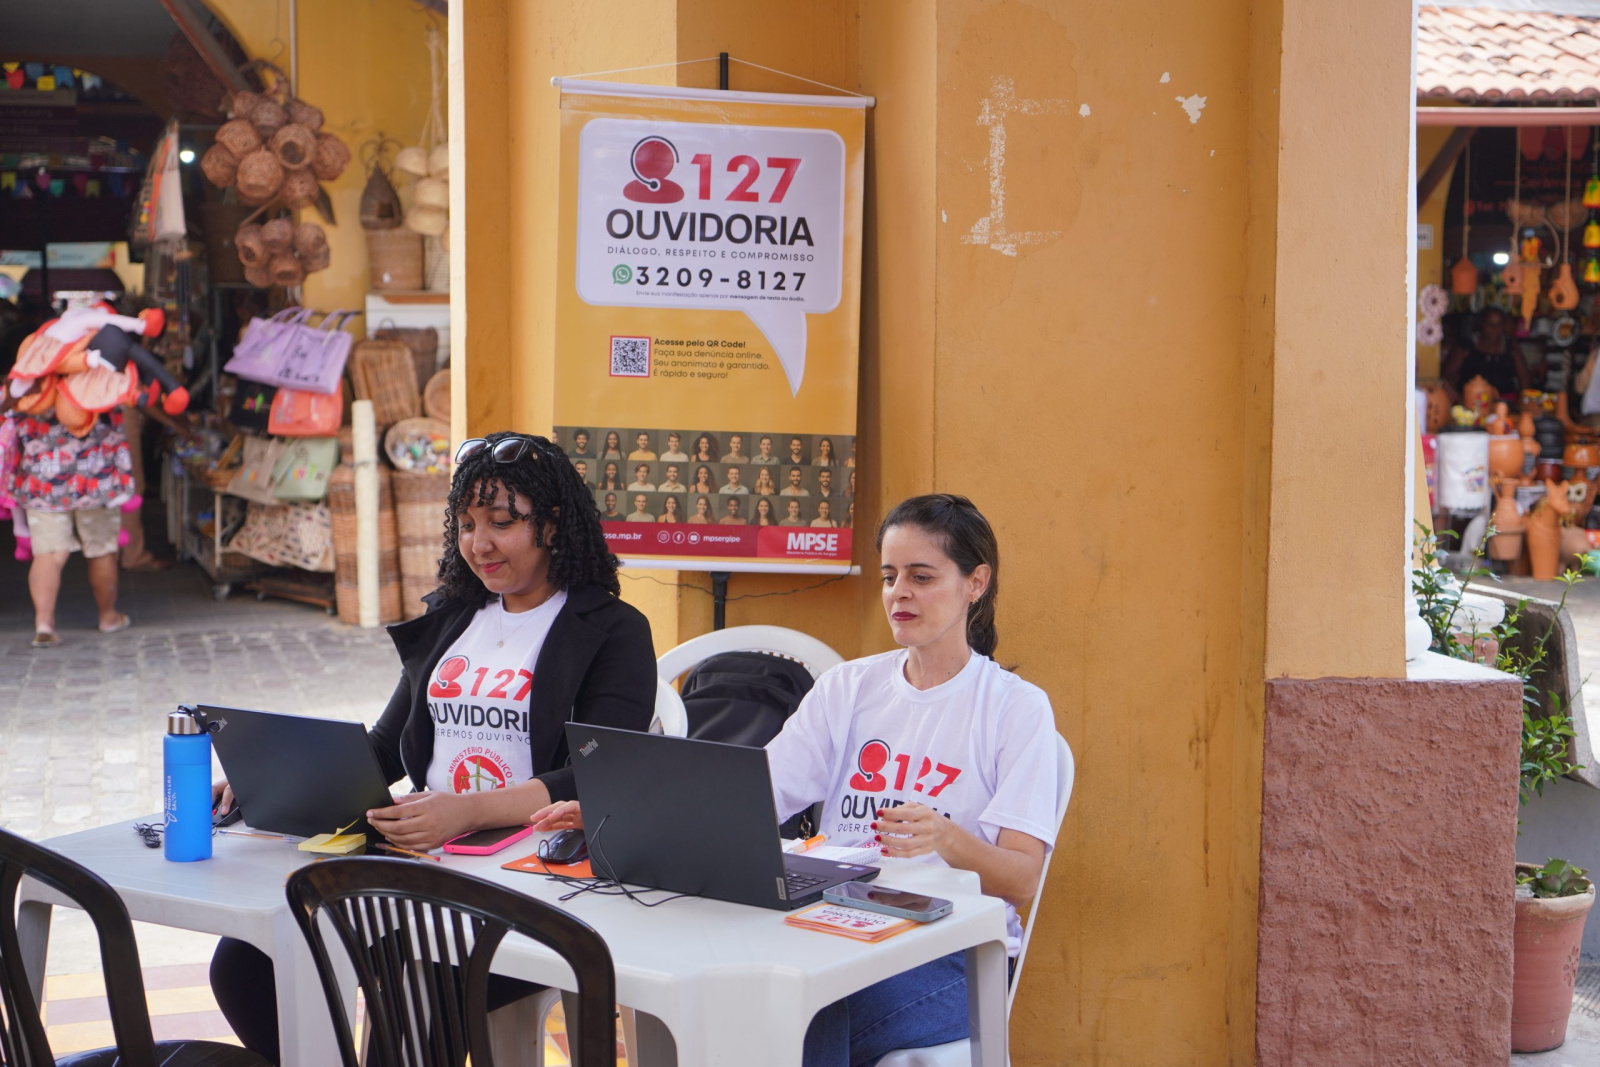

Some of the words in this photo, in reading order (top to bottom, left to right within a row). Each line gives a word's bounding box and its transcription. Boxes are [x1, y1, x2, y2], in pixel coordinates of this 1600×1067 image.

[690, 153, 802, 203] 127
[606, 208, 815, 247] OUVIDORIA
[607, 245, 661, 257] DIÁLOGO,
[665, 248, 716, 258] RESPEITO
[721, 250, 726, 259] E
[730, 251, 814, 262] COMPROMISSO
[636, 266, 806, 291] 3209-8127
[654, 338, 684, 346] Acesse
[686, 339, 704, 348] pelo
[721, 340, 746, 348] Code!
[654, 348, 674, 358] Faça
[694, 350, 734, 358] denúncia
[736, 350, 763, 359] online.
[653, 368, 658, 376] É
[660, 369, 688, 379] rápido
[671, 360, 717, 368] anonimato
[727, 362, 770, 371] garantido.
[602, 532, 642, 540] pse.mp.br
[703, 535, 740, 543] mpsergipe
[787, 532, 838, 551] MPSE
[470, 667, 533, 701] 127
[428, 702, 531, 733] OUVIDORI
[435, 729, 472, 740] EREMOS
[477, 731, 512, 742] OUVIR
[449, 747, 483, 773] MINISTÉRIO
[485, 748, 513, 778] PÚBLICO
[814, 914, 847, 924] 127
[822, 909, 886, 924] OUVIDORIA
